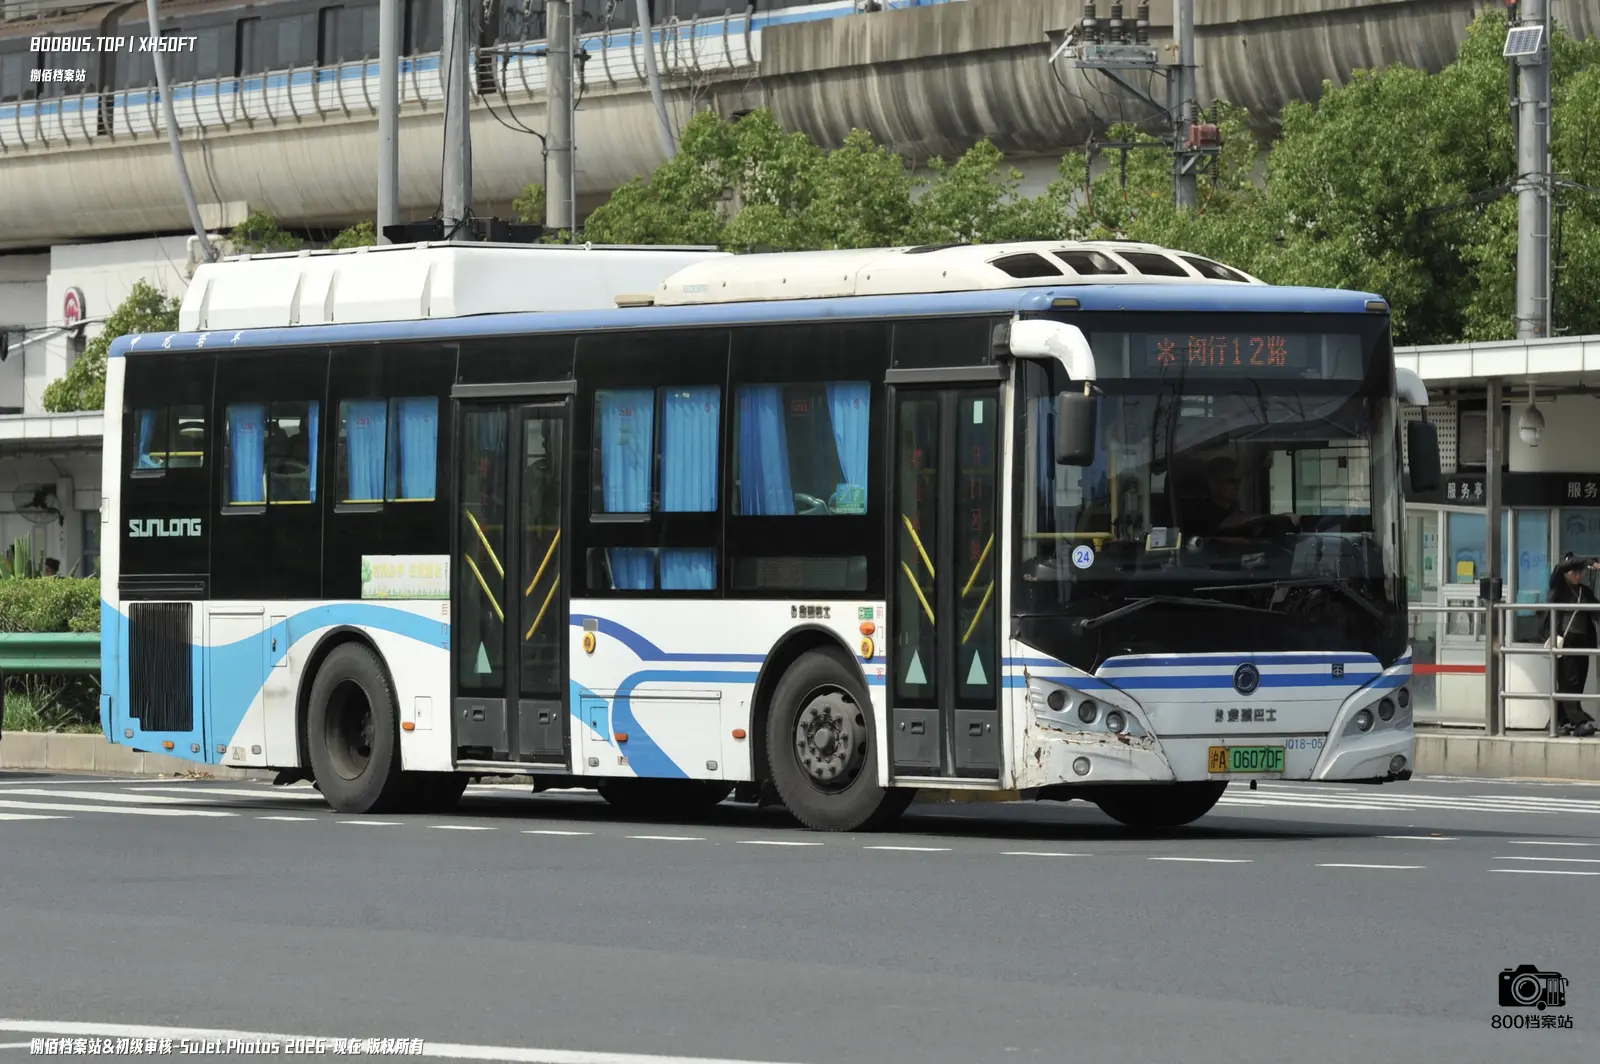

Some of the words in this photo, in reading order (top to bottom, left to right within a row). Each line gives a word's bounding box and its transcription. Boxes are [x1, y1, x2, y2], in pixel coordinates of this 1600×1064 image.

[1447, 482, 1483, 499] 服务亭
[1567, 481, 1598, 498] 服务
[129, 518, 202, 537] SUNLONG
[1077, 551, 1090, 563] 24
[1210, 751, 1227, 769] 沪A
[1233, 750, 1283, 769] 06070F
